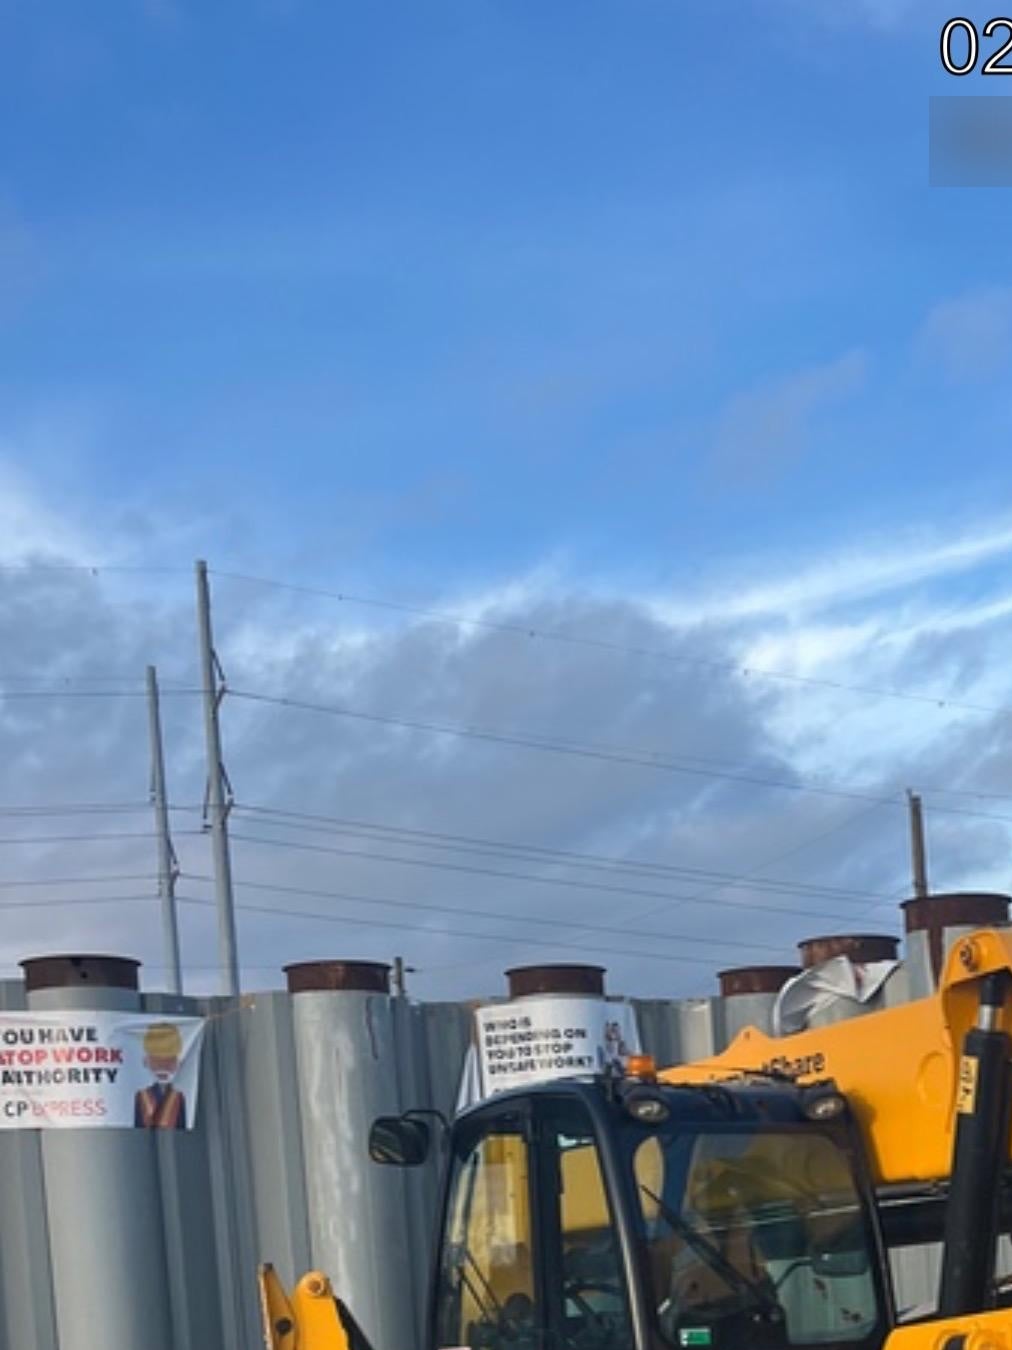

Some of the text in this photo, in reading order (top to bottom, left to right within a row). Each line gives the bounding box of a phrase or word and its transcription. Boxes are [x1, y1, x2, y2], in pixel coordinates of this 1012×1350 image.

[2, 1028, 97, 1044] OU HAVE
[563, 1028, 587, 1039] ON
[53, 1047, 123, 1064] WORK
